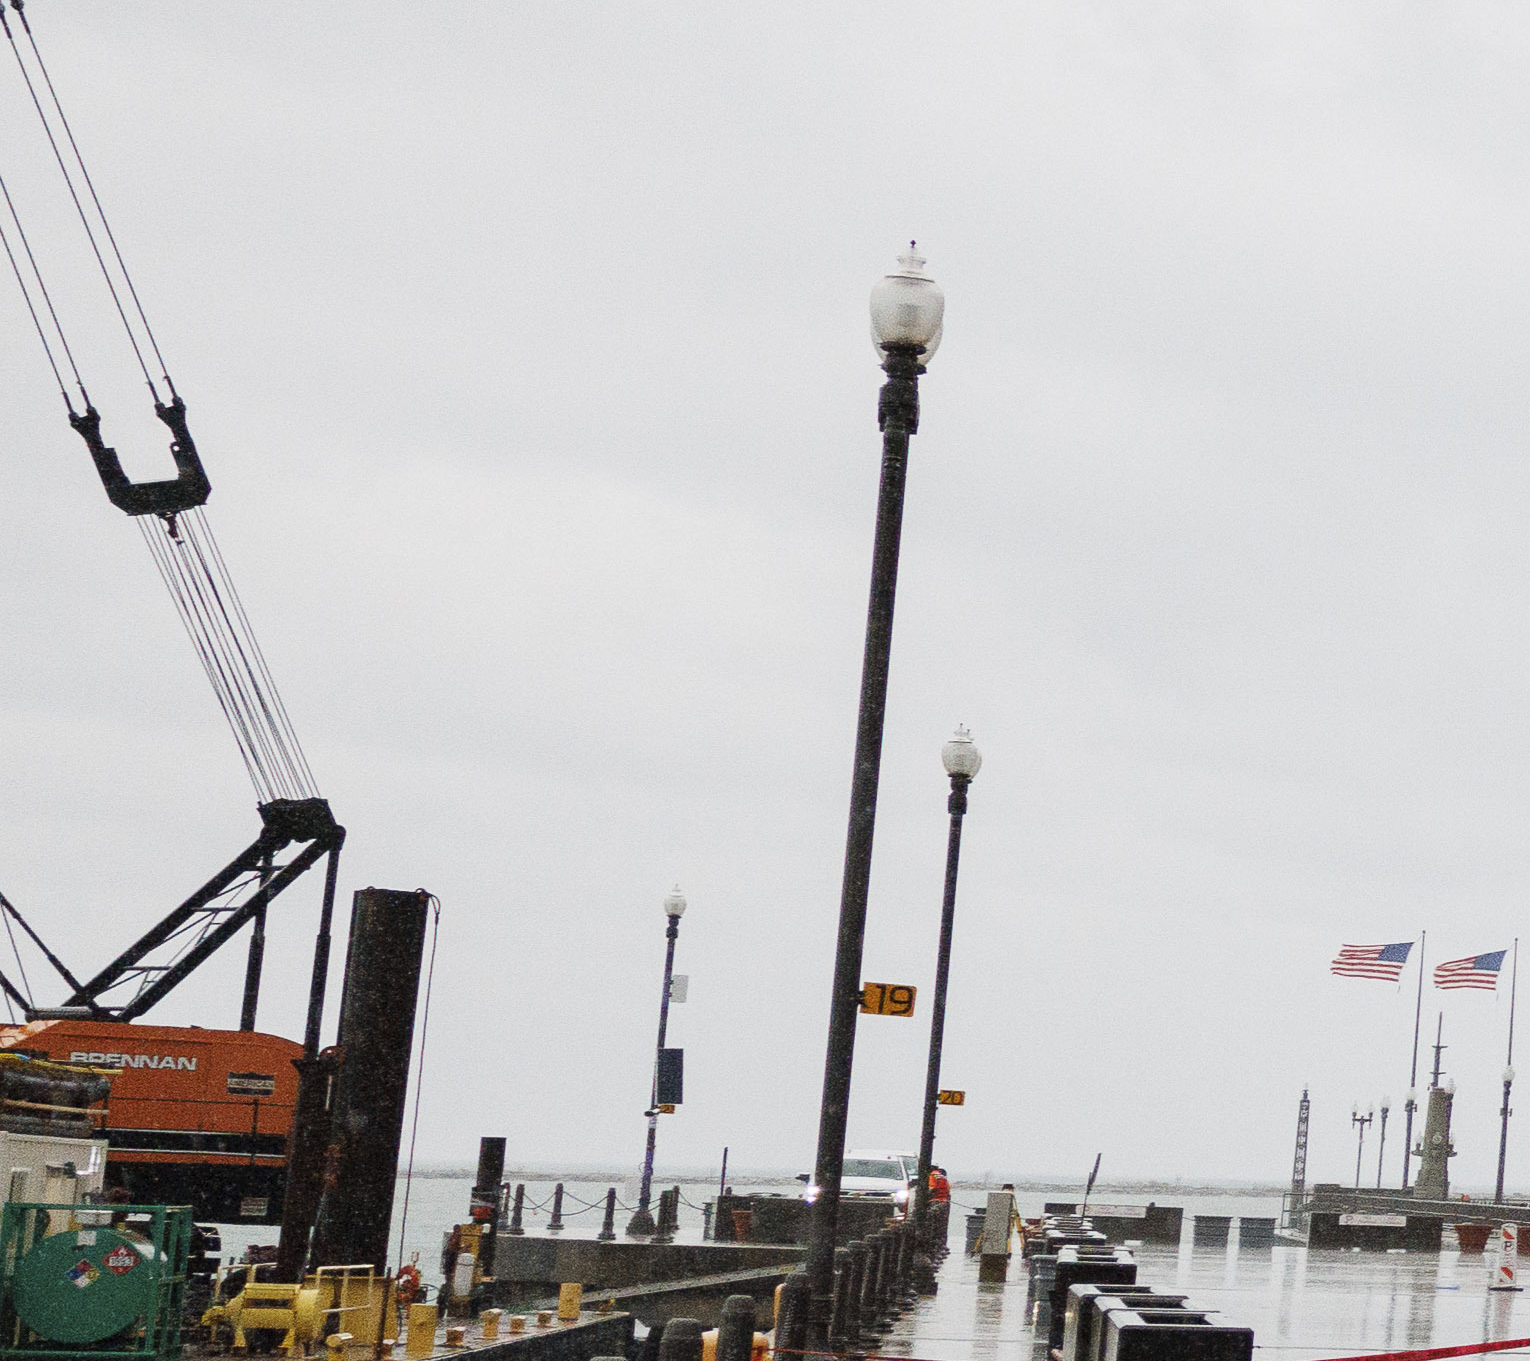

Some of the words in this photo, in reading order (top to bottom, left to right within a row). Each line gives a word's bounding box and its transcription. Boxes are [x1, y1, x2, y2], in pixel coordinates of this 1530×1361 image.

[876, 985, 913, 1014] 19
[70, 1051, 197, 1070] BRENNAN
[942, 1090, 963, 1105] 20
